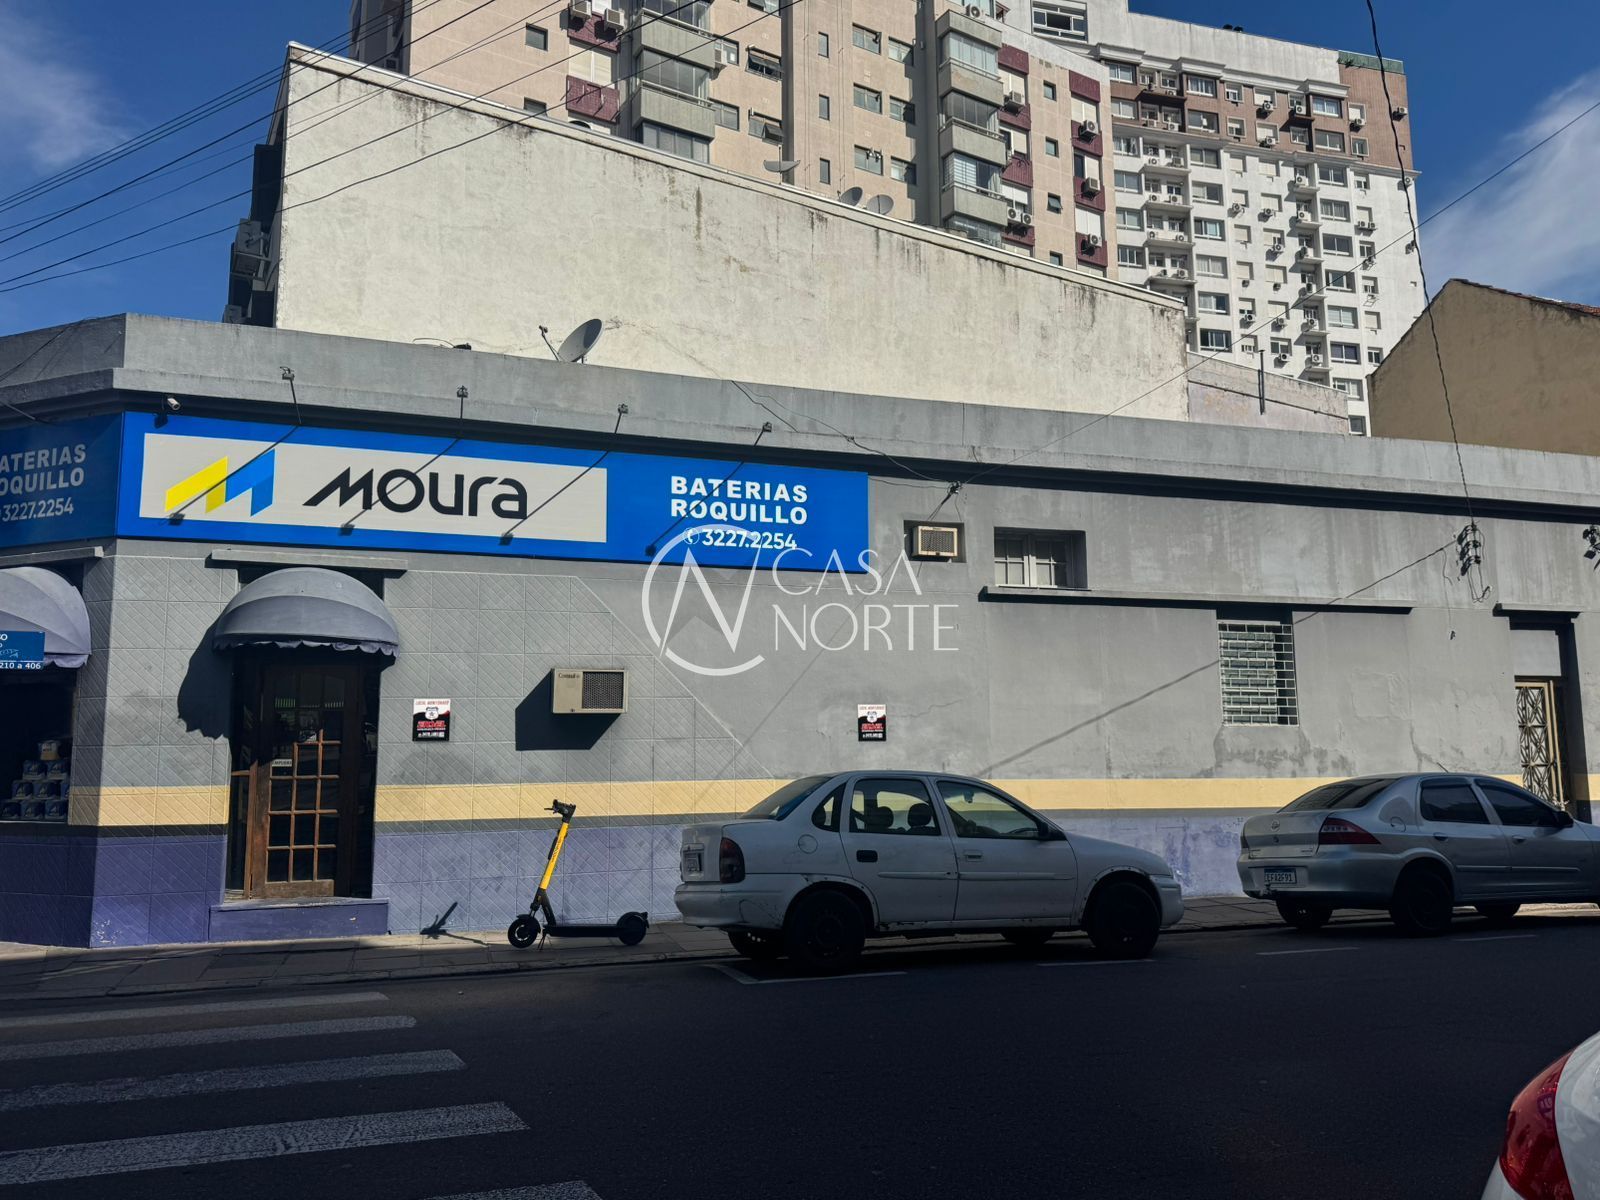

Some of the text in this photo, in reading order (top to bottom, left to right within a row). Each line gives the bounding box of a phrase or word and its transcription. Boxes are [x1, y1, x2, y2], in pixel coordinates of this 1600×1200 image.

[670, 475, 808, 503] BATERIAS
[2, 497, 75, 522] 3227.2254
[670, 498, 808, 525] ROQUILLO
[702, 528, 797, 550] 3227.2254
